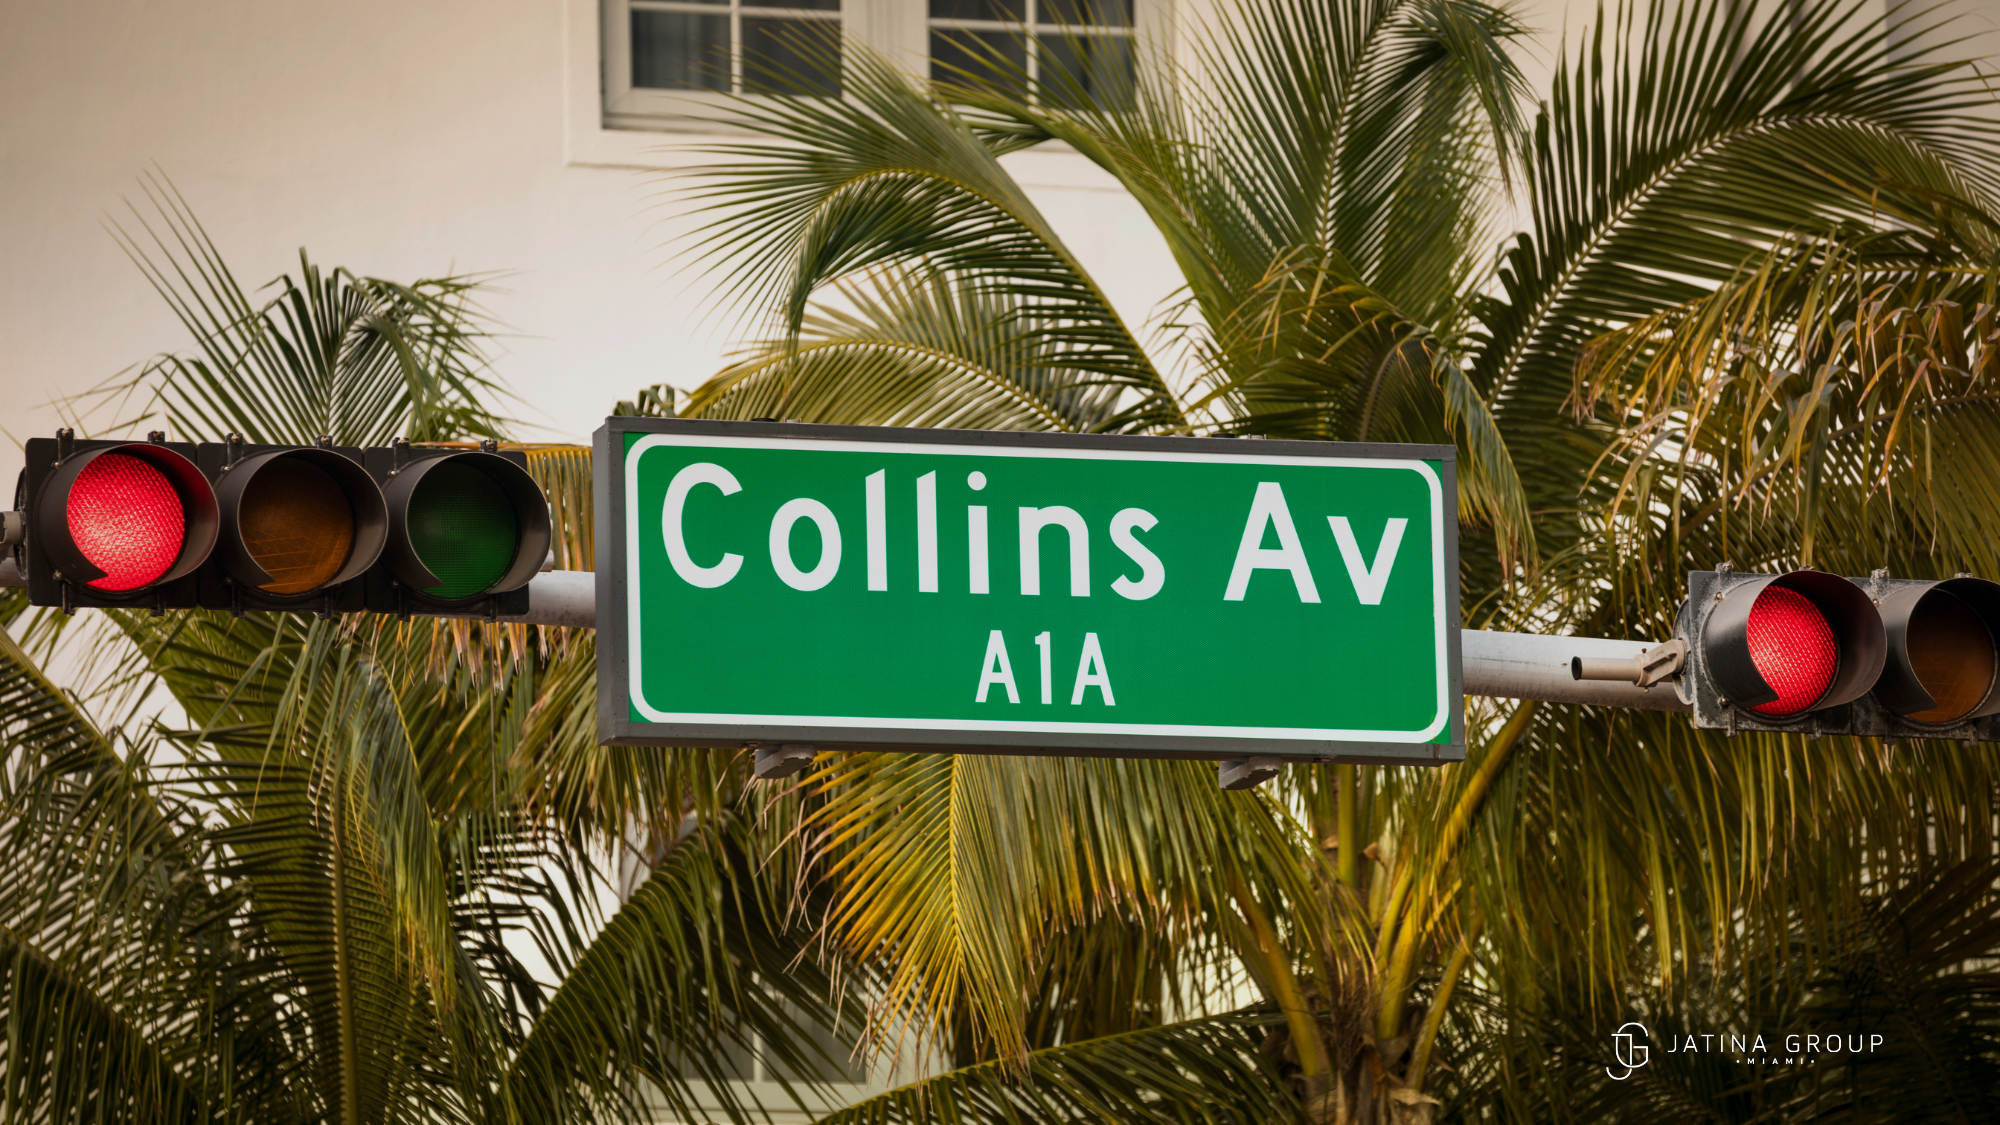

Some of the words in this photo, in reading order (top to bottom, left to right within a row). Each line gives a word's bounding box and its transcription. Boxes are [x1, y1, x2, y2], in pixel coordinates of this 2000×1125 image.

[661, 462, 1166, 601] Collins
[1223, 481, 1409, 606] Av
[975, 629, 1116, 706] A1A
